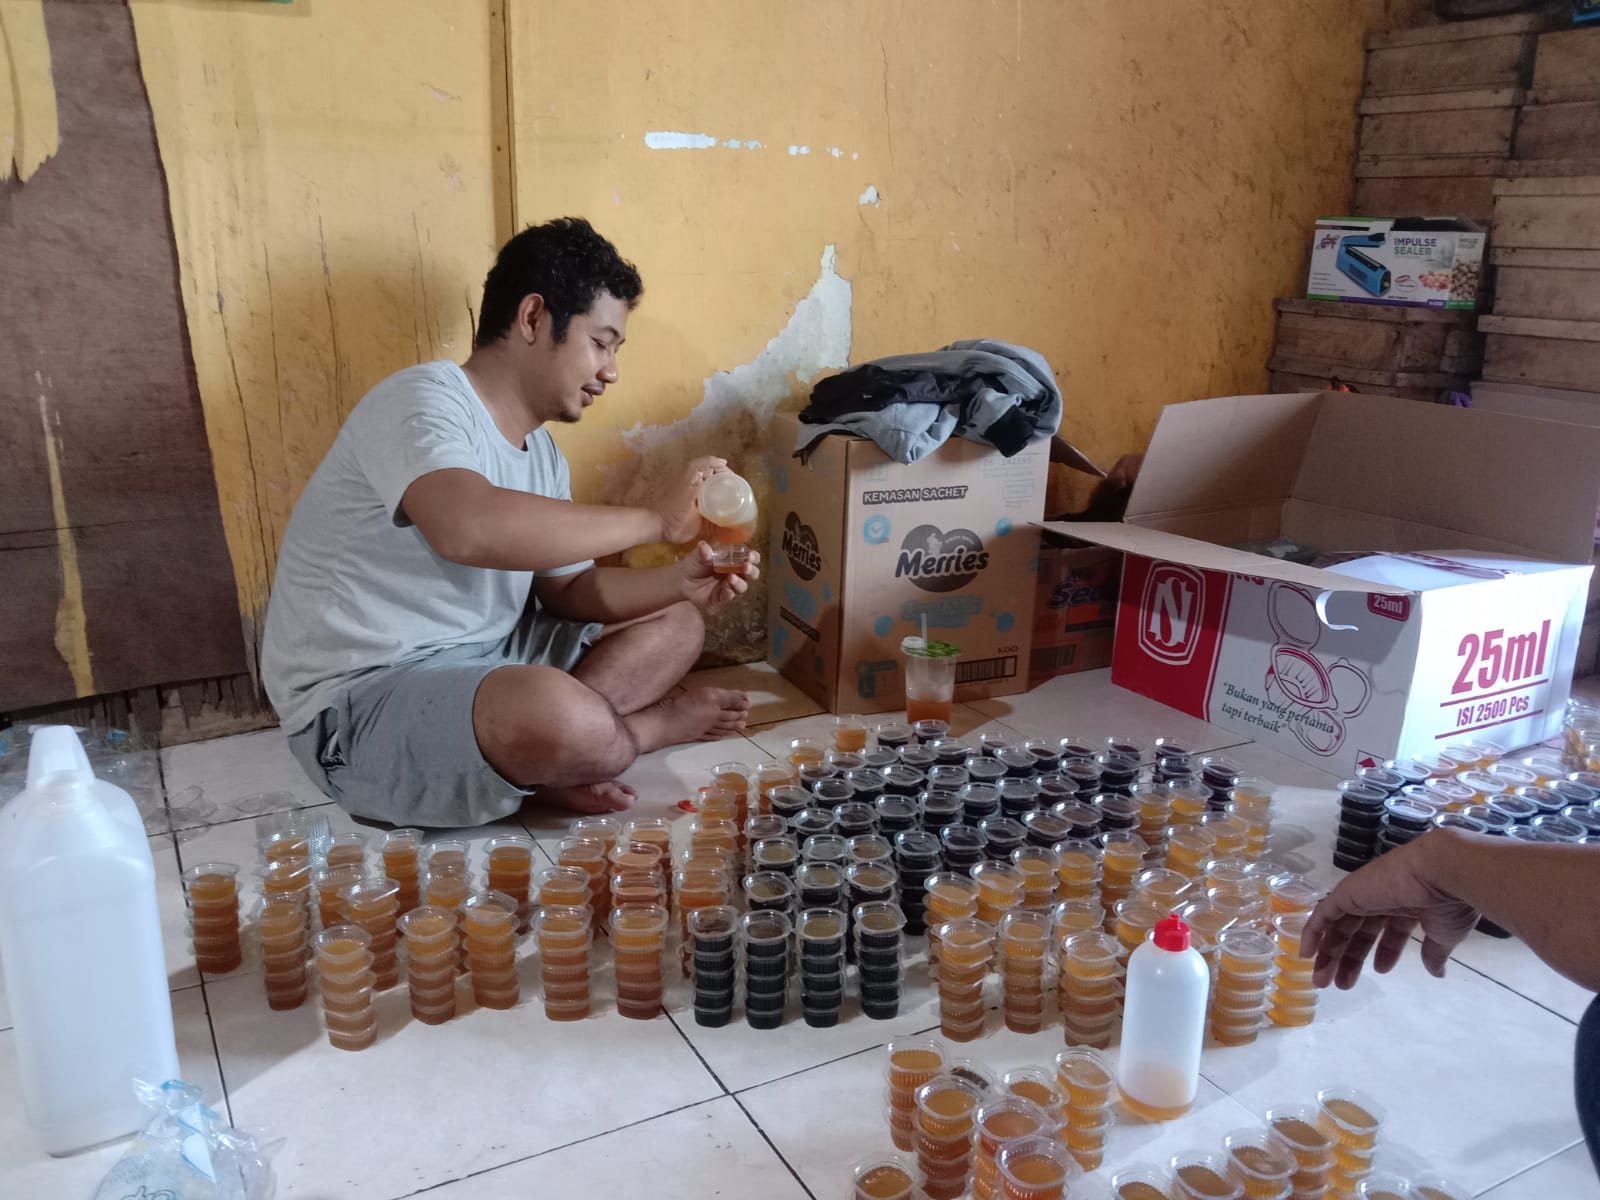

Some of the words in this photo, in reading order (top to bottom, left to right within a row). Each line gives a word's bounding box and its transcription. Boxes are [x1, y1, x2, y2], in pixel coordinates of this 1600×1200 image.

[1394, 238, 1437, 247] IMPULSE
[1394, 247, 1432, 255] SEALER
[863, 490, 920, 504] KEMASAN
[922, 486, 968, 501] SACHET
[782, 530, 822, 573] Merries
[895, 546, 989, 578] Merries
[1373, 594, 1404, 614] 25ml
[1451, 619, 1551, 694] 25ml
[1221, 703, 1242, 719] tapi
[1262, 699, 1287, 718] yang
[1288, 709, 1335, 733] pertama
[1456, 708, 1474, 727] ISI
[1475, 698, 1506, 723] 2500
